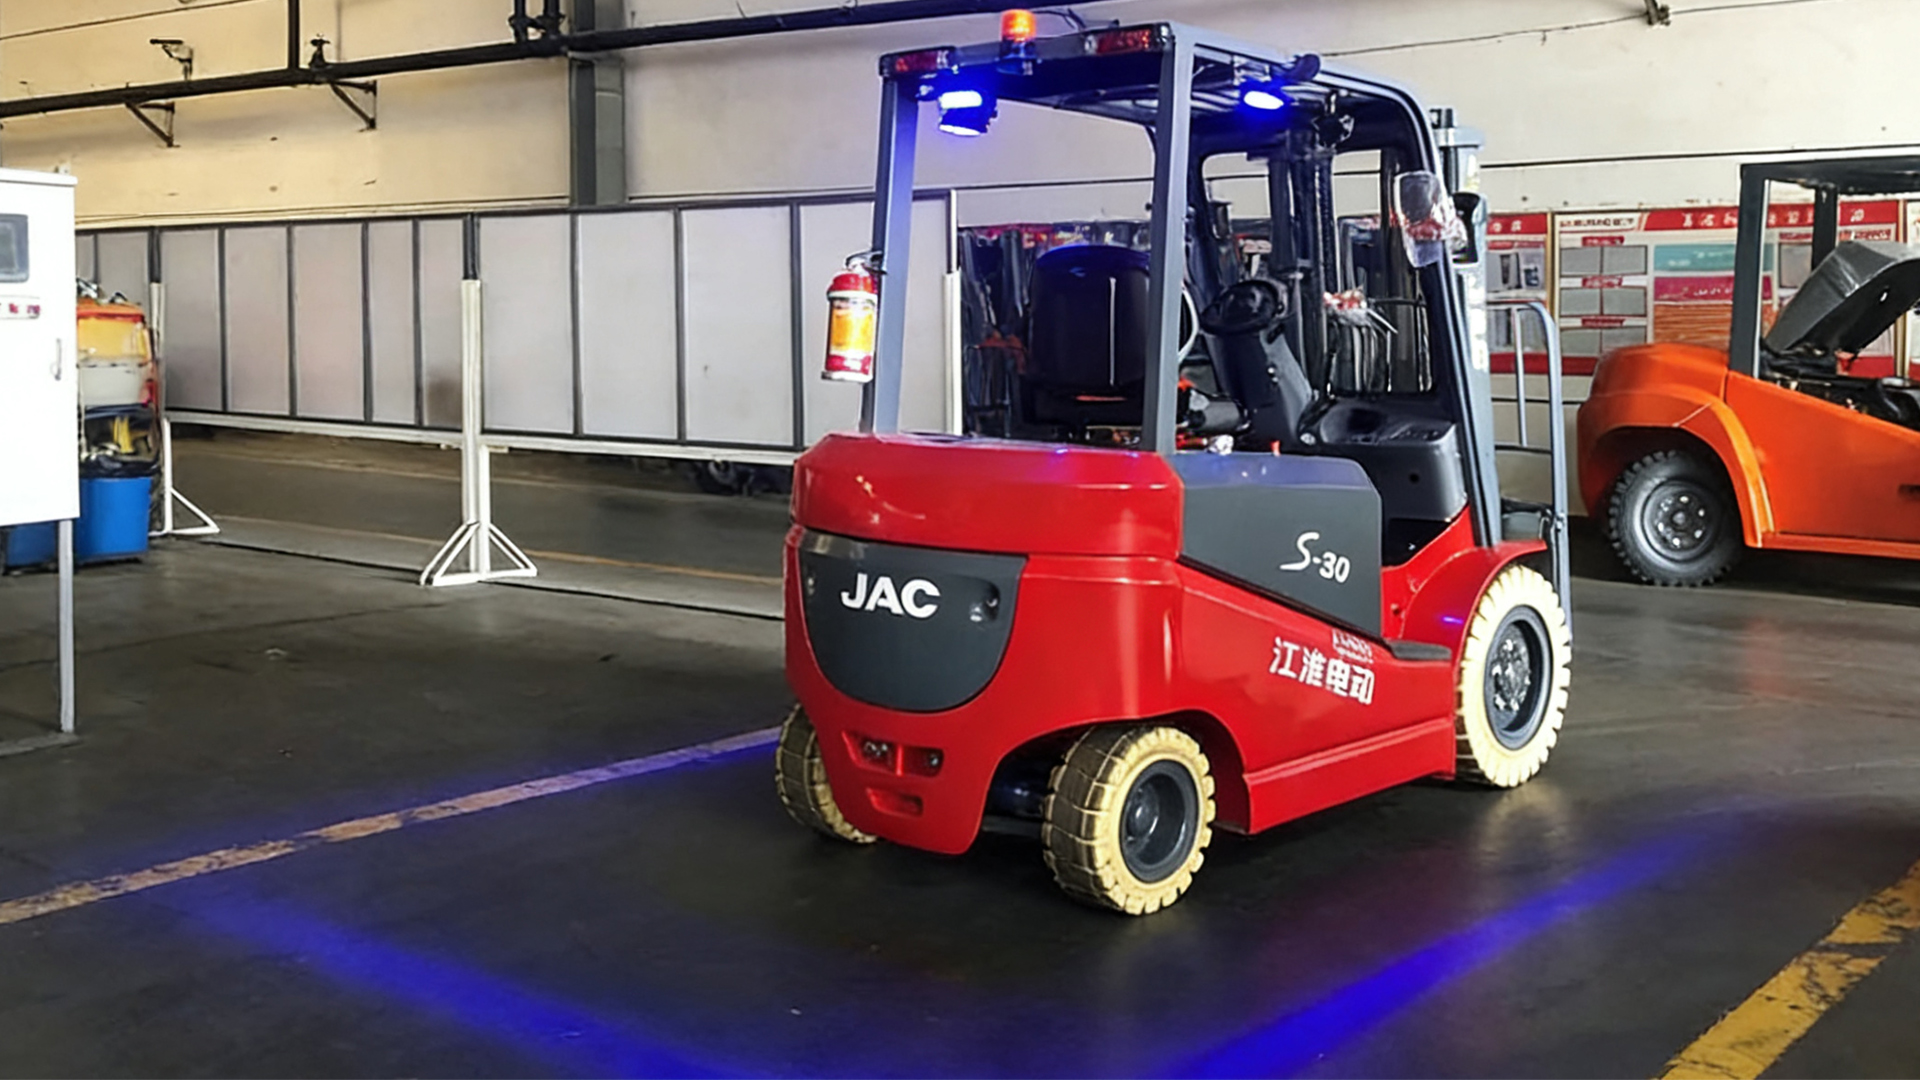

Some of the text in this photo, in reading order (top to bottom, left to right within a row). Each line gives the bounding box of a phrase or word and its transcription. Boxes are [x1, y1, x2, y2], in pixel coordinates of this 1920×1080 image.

[1279, 531, 1351, 583] S-30
[840, 573, 942, 619] JAC
[1269, 636, 1375, 705] 江淮电动
